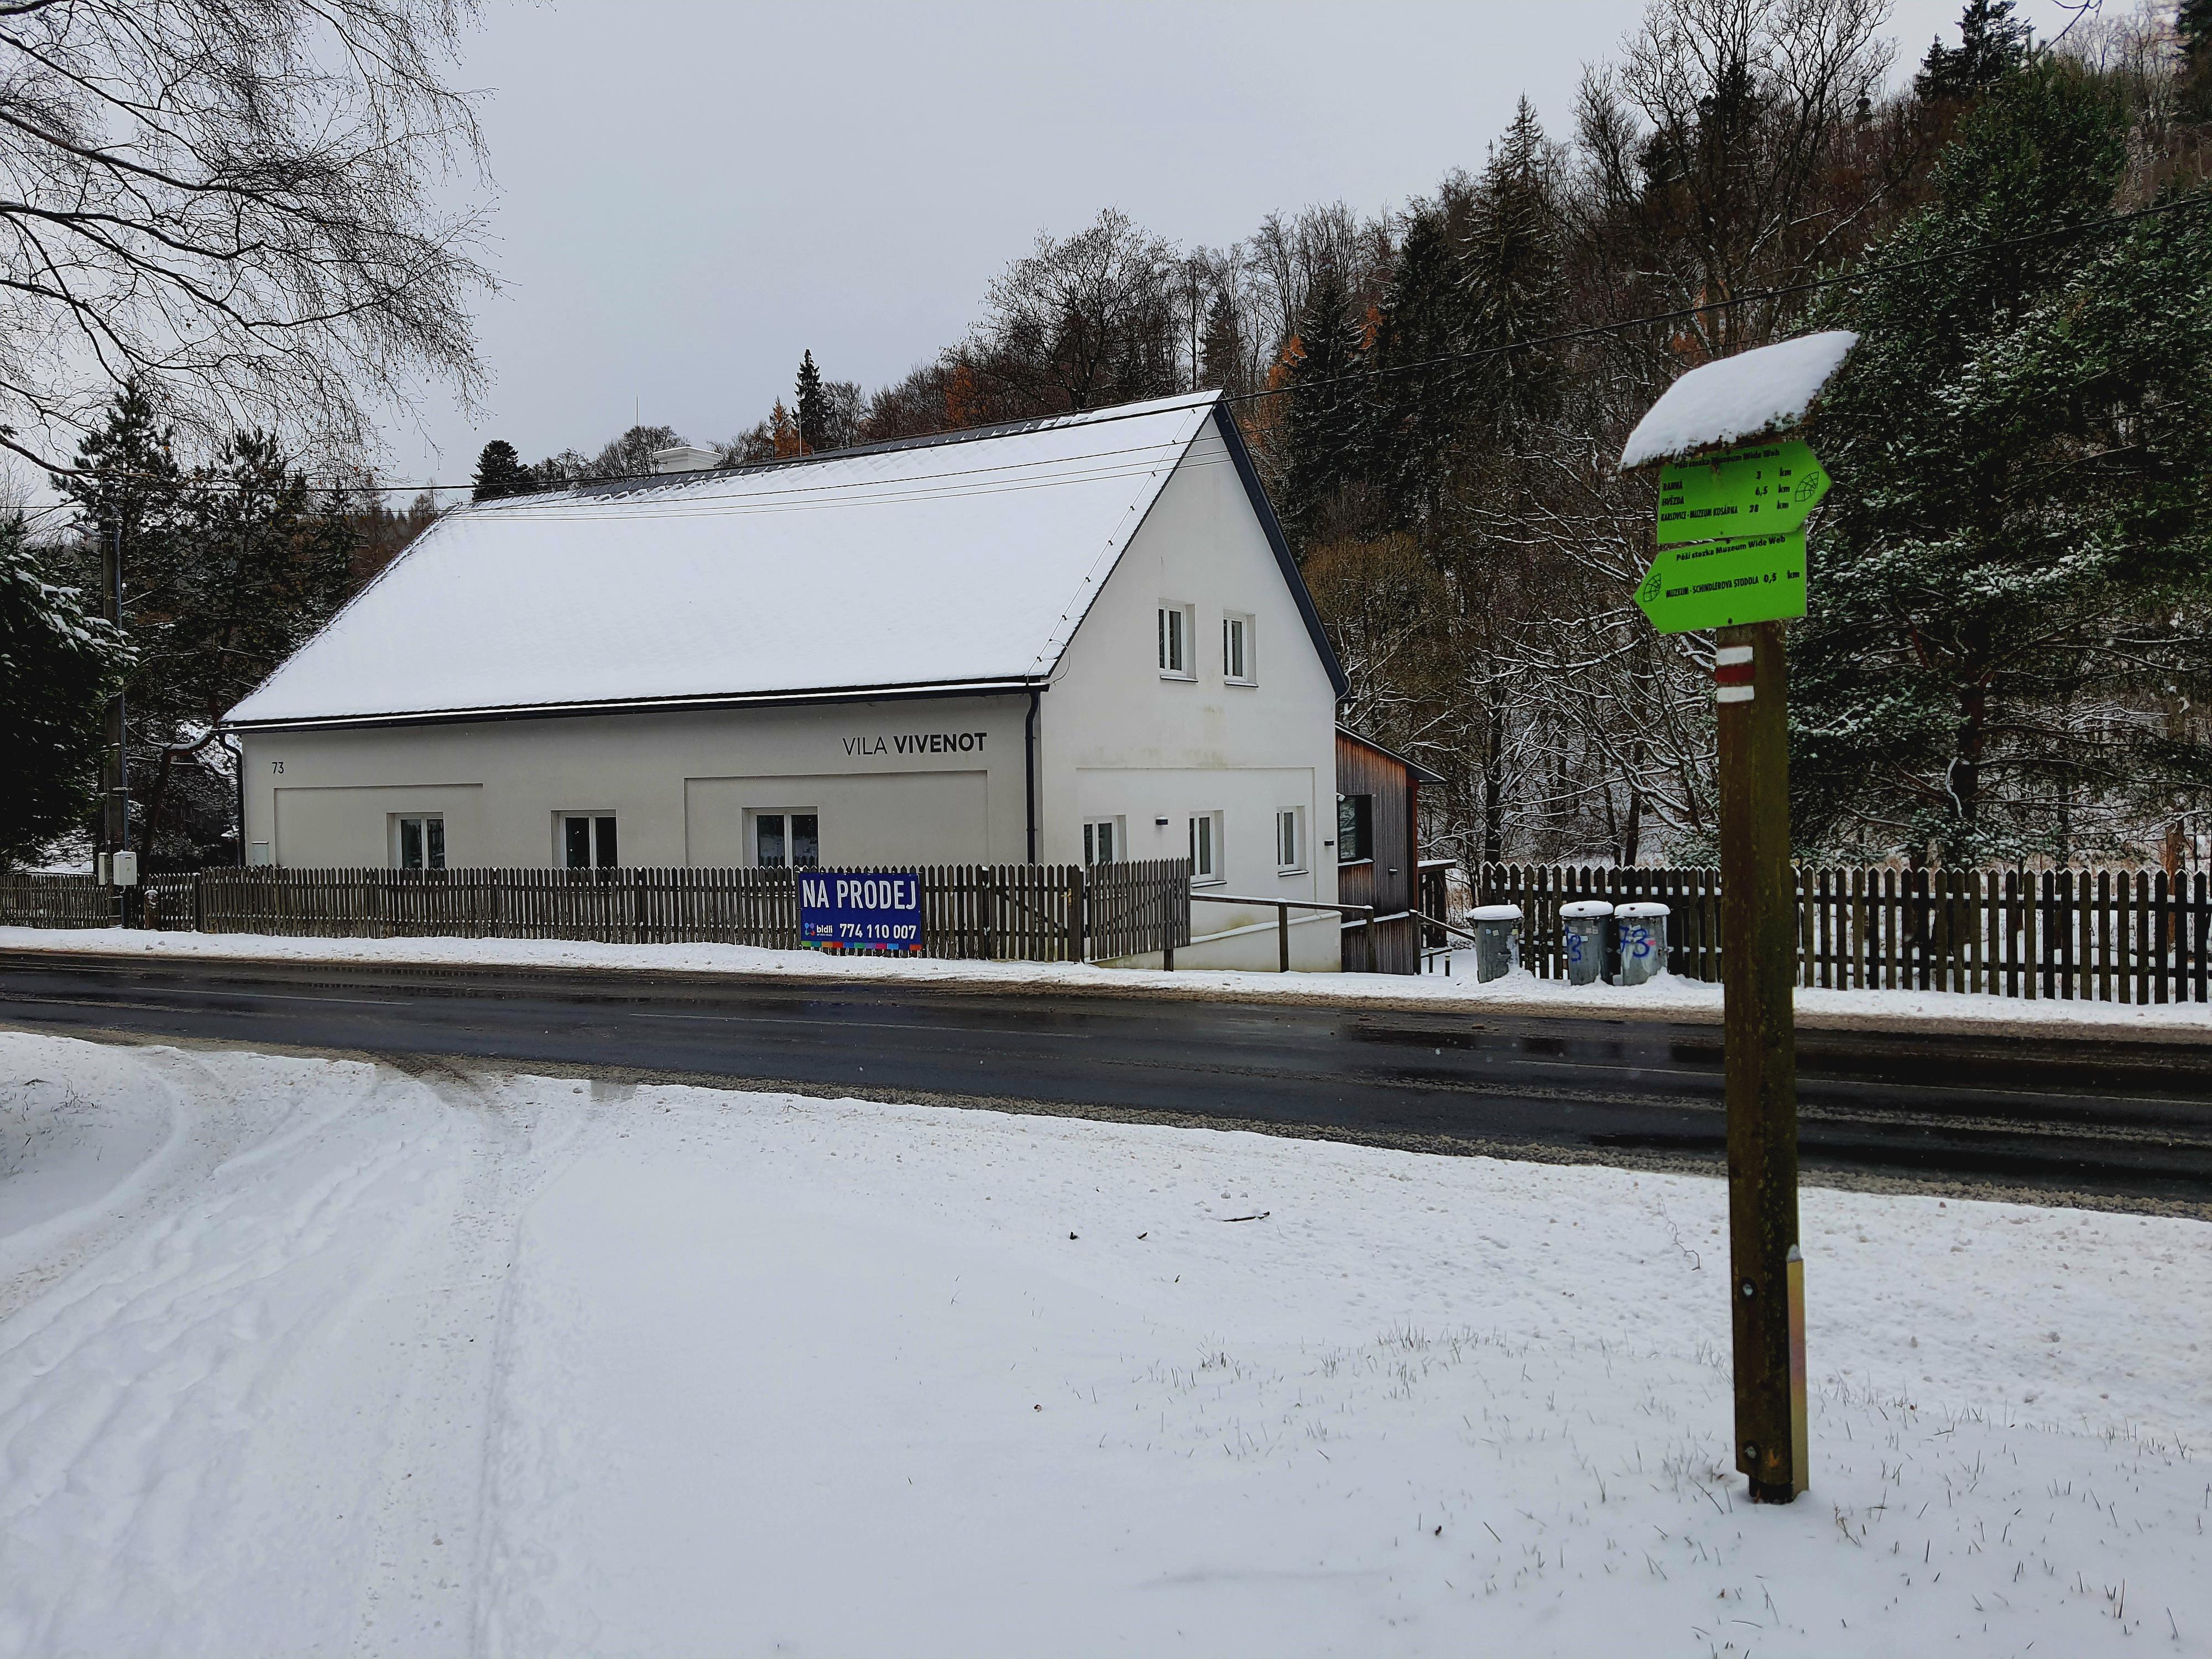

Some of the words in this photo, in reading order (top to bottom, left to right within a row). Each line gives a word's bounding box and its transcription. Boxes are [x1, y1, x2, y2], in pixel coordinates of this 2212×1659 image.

[1763, 448, 1780, 457] Web
[1779, 466, 1792, 477] km
[1662, 494, 1684, 507] HVĚZDA
[1755, 486, 1768, 497] 6,5
[1778, 483, 1791, 493] km
[1661, 510, 1687, 521] KARLOVICE
[1690, 508, 1712, 518] MUZEUM
[1713, 504, 1738, 516] KOSÁRNA
[1749, 504, 1759, 513] 28
[1777, 500, 1789, 509] km
[1676, 551, 1690, 561] Pěší
[1692, 550, 1714, 559] stezka
[1716, 544, 1746, 554] Muzeum
[1748, 538, 1766, 548] Wide
[1768, 535, 1786, 545] Web
[1666, 587, 1689, 598] MUZEUM
[1693, 580, 1733, 594] SCHINDLEROVA
[1734, 575, 1759, 587] STODOLA
[1764, 572, 1777, 584] 0,5
[1787, 570, 1800, 579] km
[842, 736, 888, 755] VILA
[893, 732, 987, 754] VIVENOT
[272, 761, 284, 774] 73
[802, 880, 829, 908] NA
[837, 880, 916, 910] PRODEJ
[817, 925, 833, 933] bidli
[839, 923, 863, 938] 774
[867, 924, 889, 938] 110
[893, 925, 916, 939] 007
[1619, 925, 1651, 957] 73
